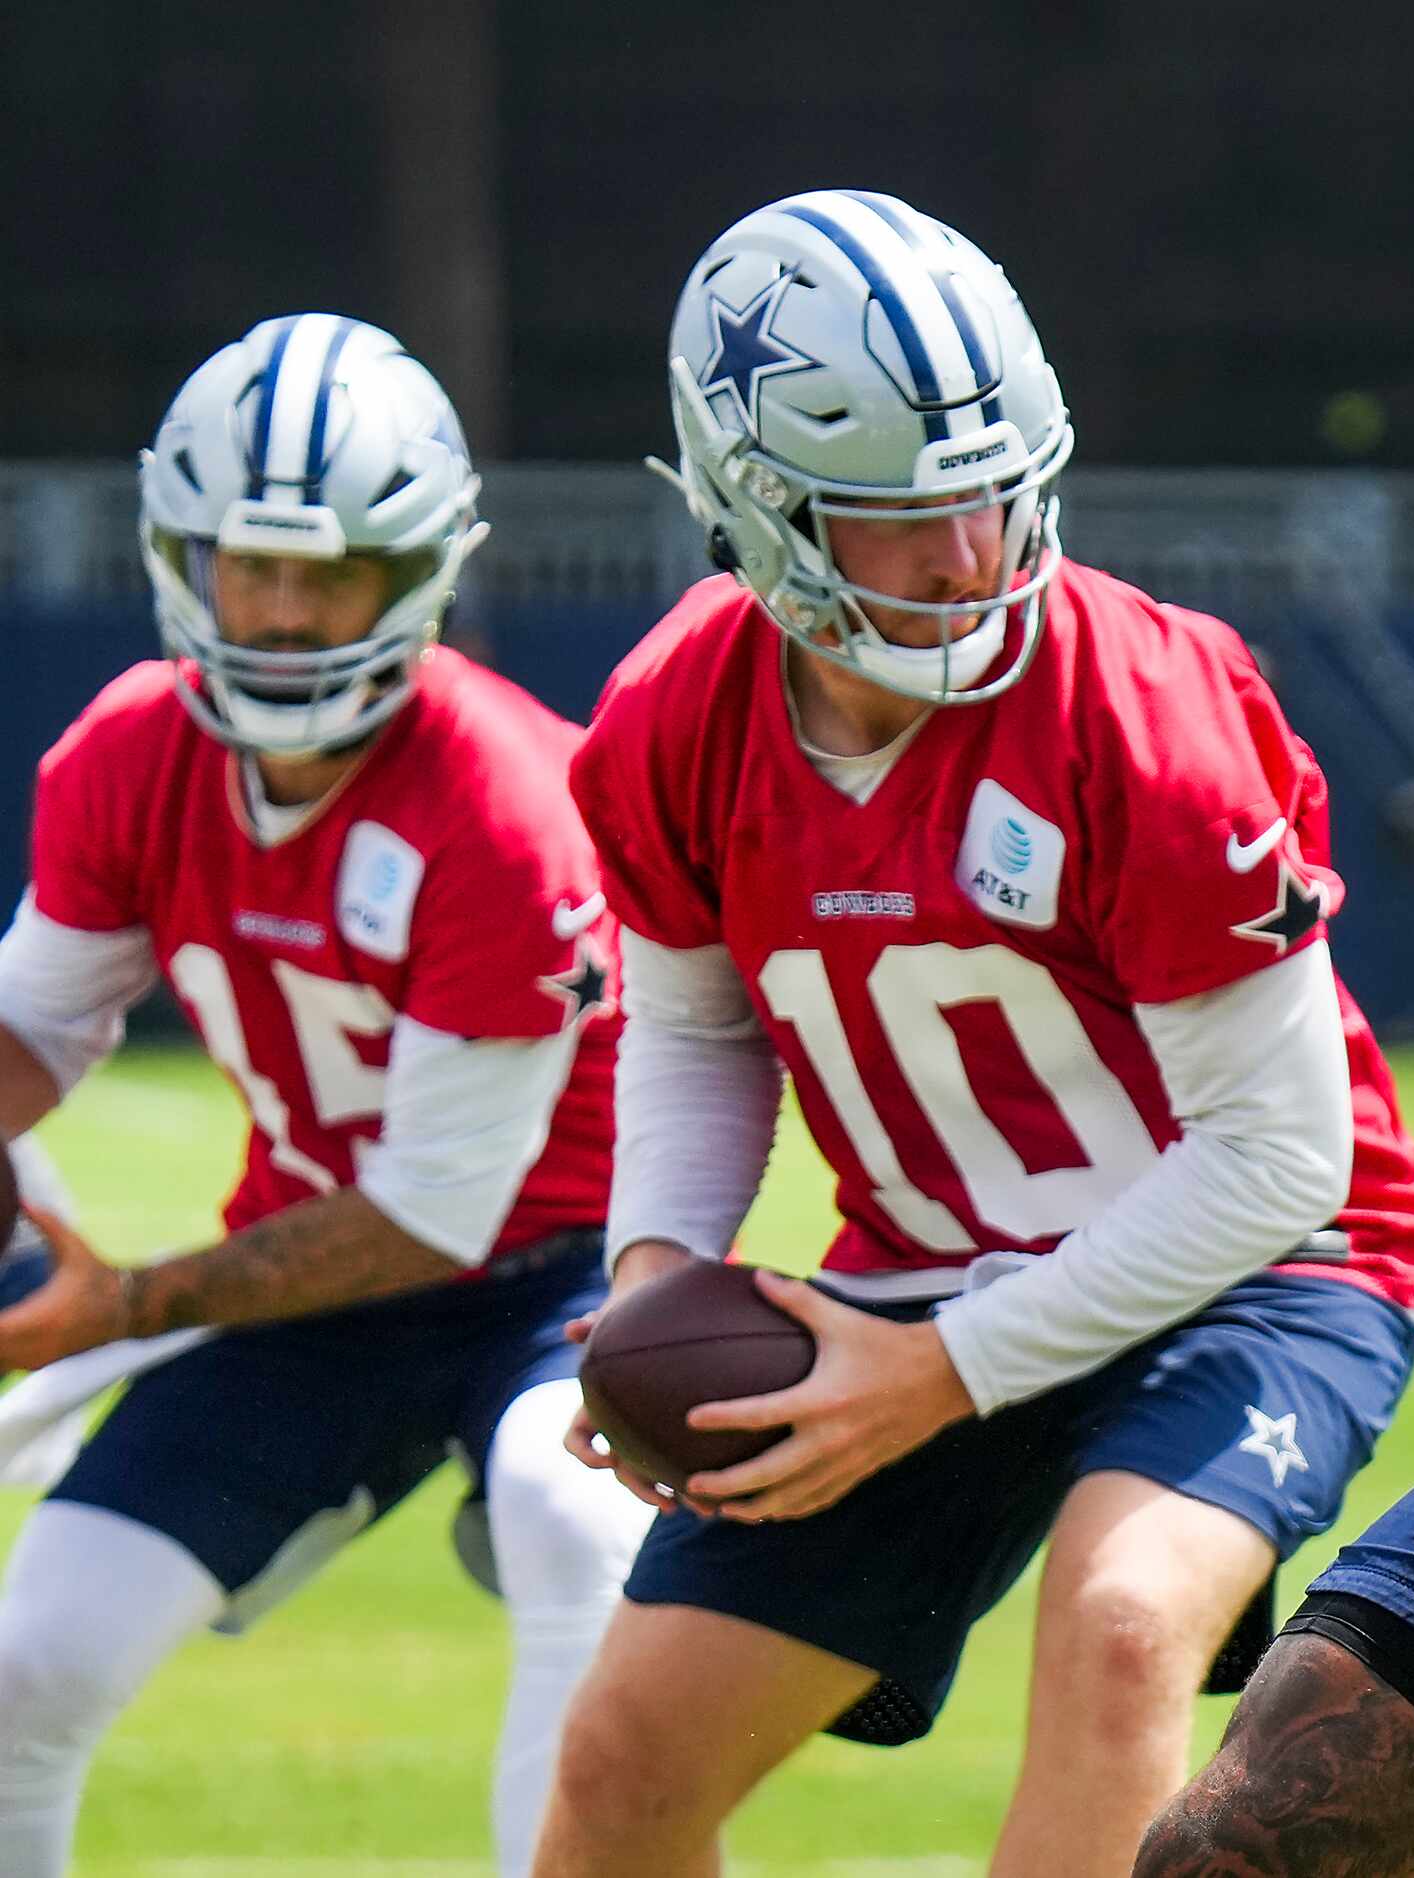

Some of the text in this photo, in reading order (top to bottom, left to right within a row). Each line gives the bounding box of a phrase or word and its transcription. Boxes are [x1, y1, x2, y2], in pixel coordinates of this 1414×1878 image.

[973, 868, 1031, 910] AT&T
[169, 942, 396, 1196] 15
[757, 941, 1166, 1255] 10
